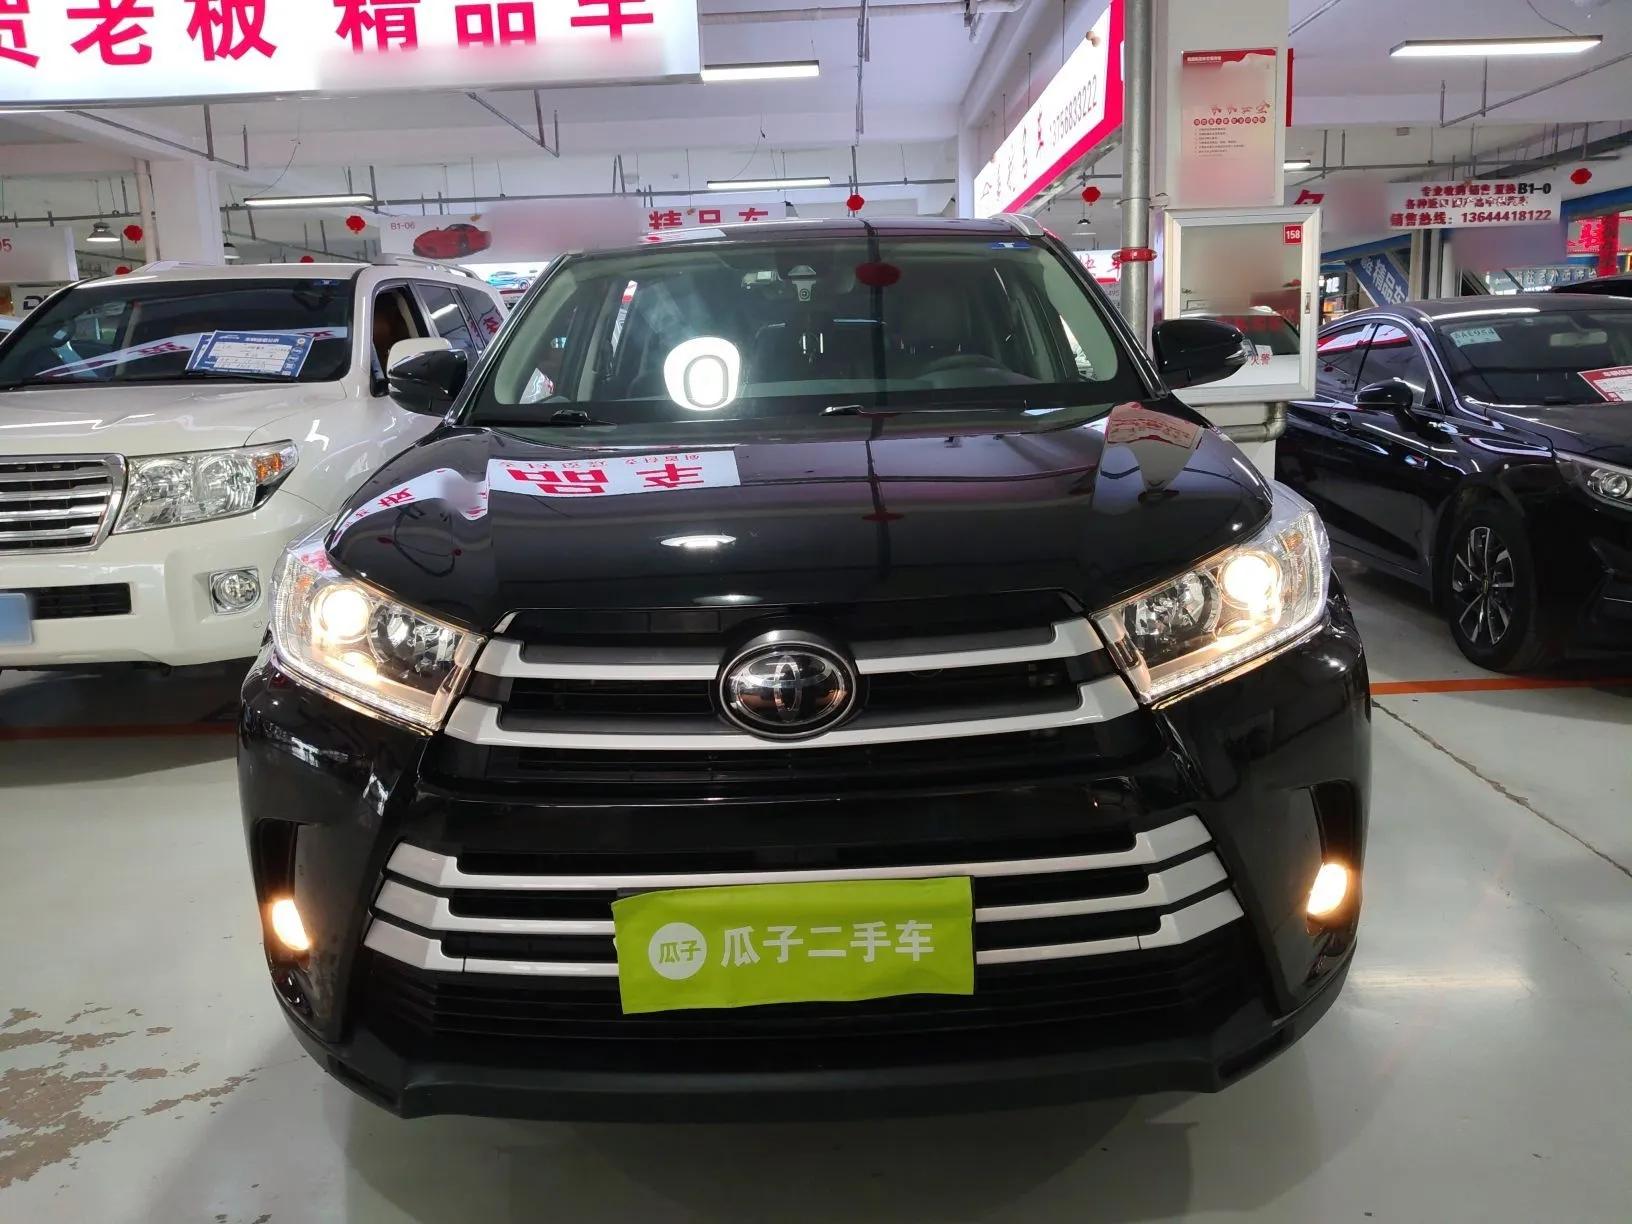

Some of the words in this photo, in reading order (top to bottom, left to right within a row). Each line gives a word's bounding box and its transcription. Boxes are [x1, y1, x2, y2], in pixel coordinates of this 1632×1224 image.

[1462, 210, 1552, 223] 13644418122
[391, 222, 415, 230] B1-06
[1285, 229, 1300, 240] 158
[720, 920, 935, 968] 瓜子二手车
[659, 939, 702, 964] 瓜子
